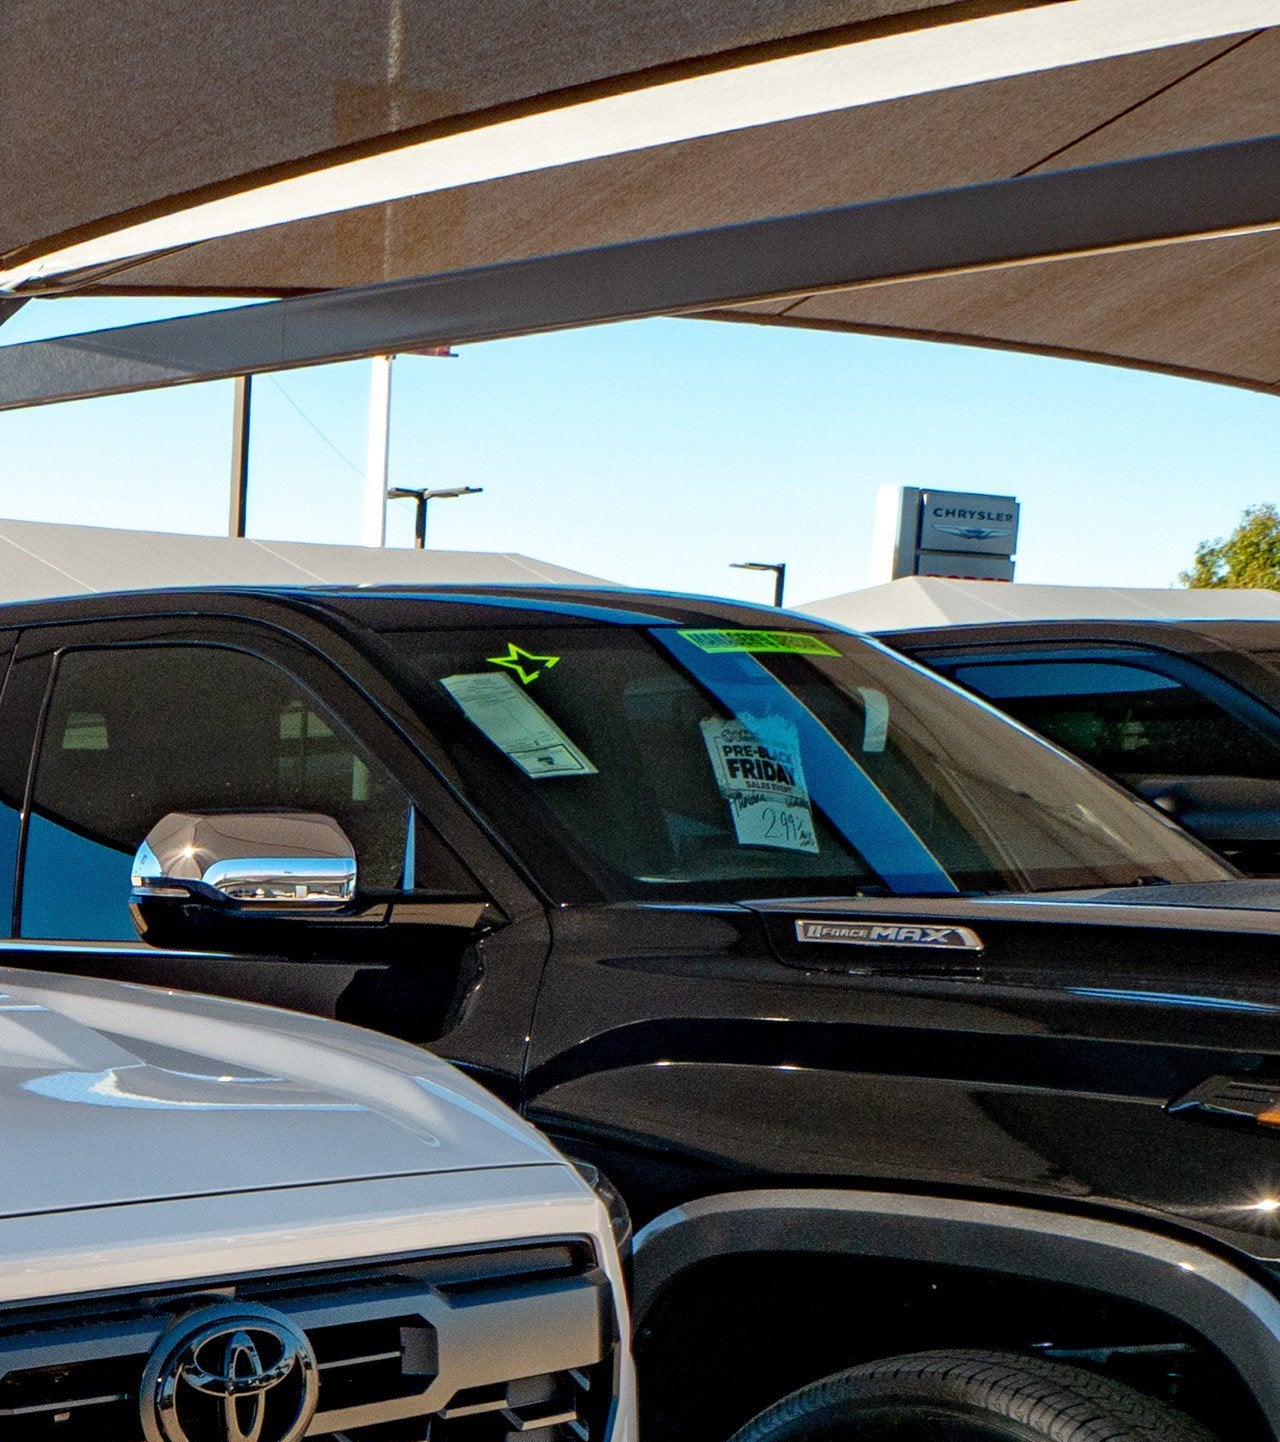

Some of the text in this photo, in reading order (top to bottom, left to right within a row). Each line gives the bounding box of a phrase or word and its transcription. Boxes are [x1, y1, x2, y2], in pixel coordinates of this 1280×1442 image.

[933, 508, 1013, 521] CHRYSLER
[726, 758, 796, 786] FRIDAY
[868, 927, 953, 942] MAX
